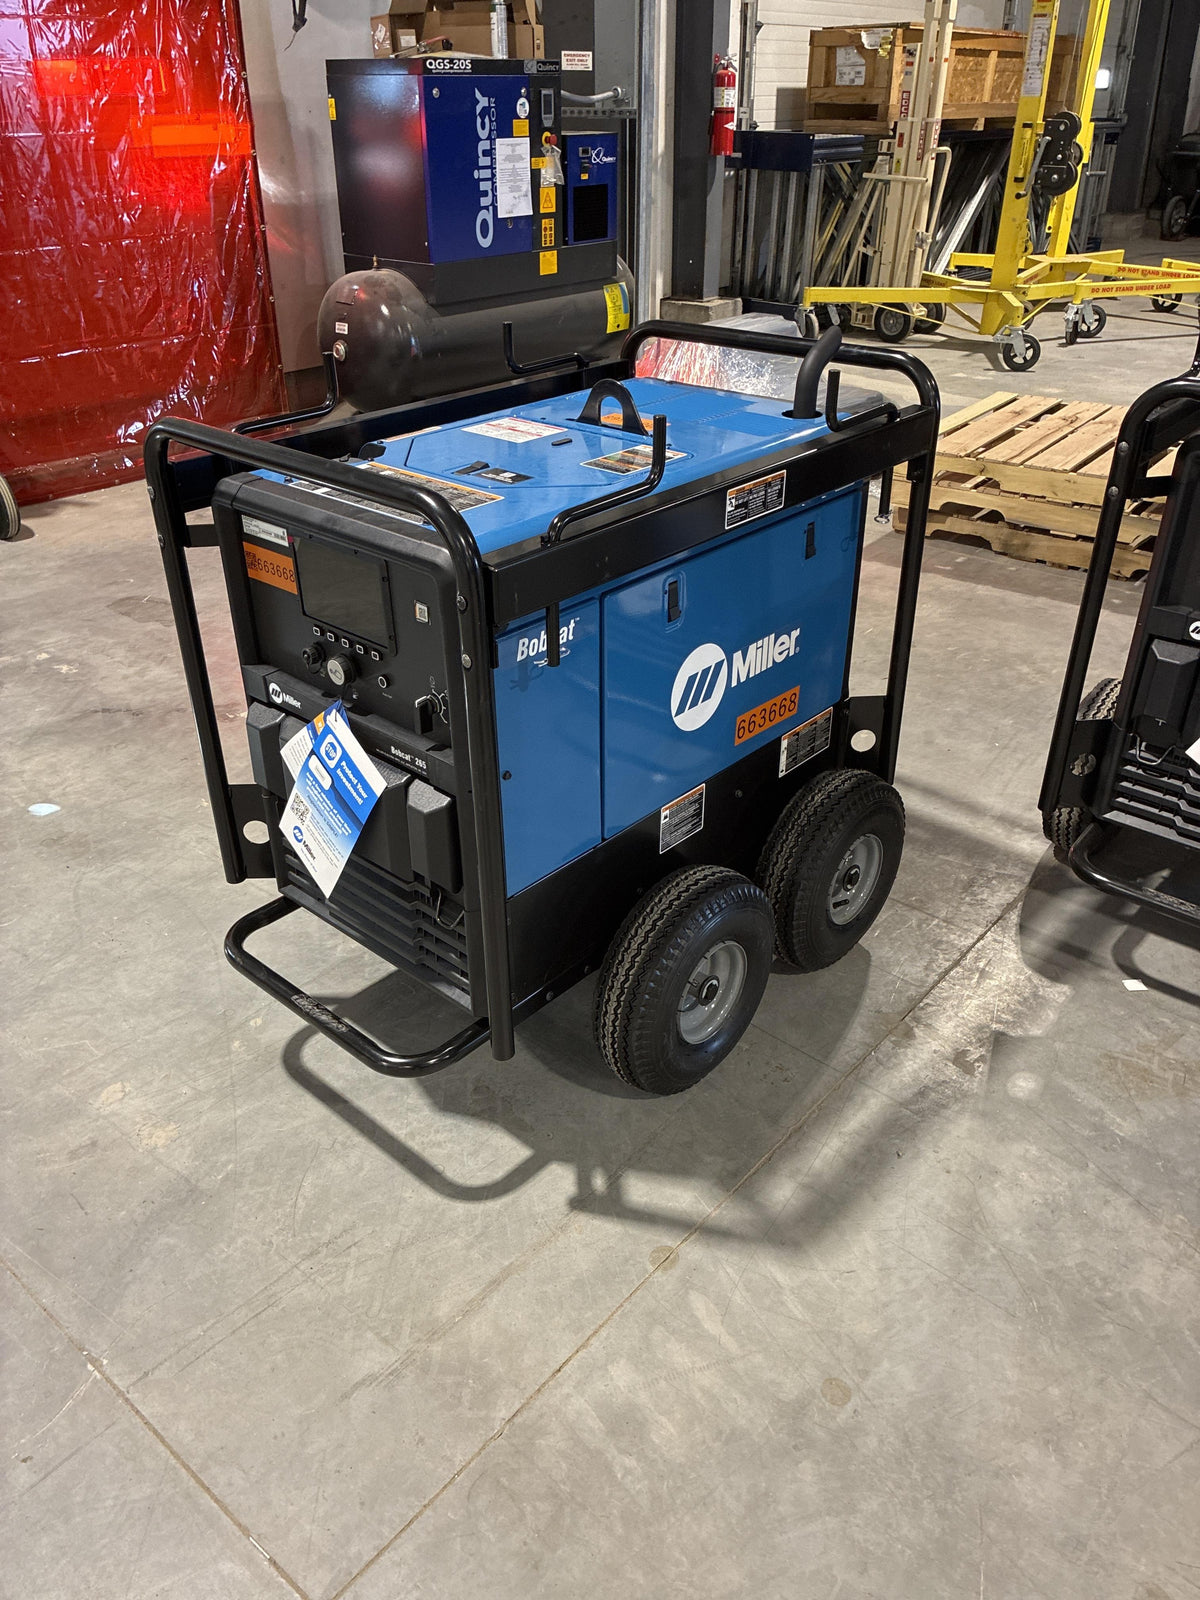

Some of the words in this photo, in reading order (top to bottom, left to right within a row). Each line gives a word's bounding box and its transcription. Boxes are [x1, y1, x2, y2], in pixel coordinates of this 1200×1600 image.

[426, 59, 472, 69] QGS-20S
[474, 87, 494, 248] Quincy
[257, 558, 296, 583] 663668
[516, 618, 576, 662] Bobat
[731, 627, 801, 688] Miller
[282, 692, 302, 709] Miller
[736, 692, 798, 740] 663668
[325, 744, 337, 759] STOP
[390, 745, 412, 762] Bobcat
[415, 757, 427, 770] 265
[336, 768, 364, 806] Investment!
[340, 760, 358, 785] Protect
[356, 782, 368, 799] Your
